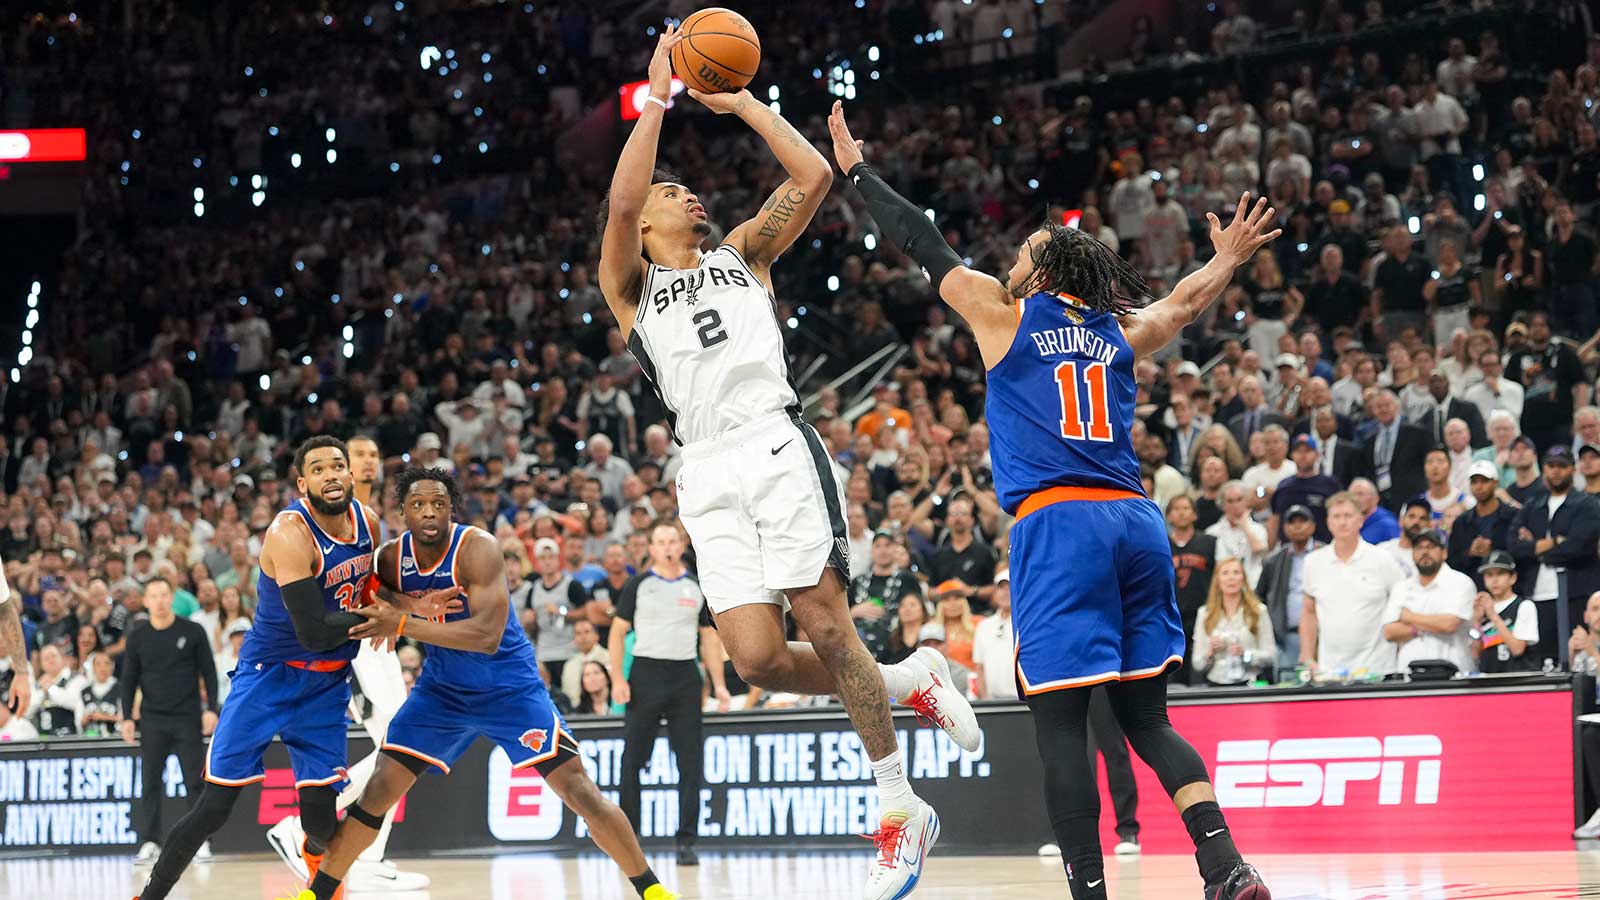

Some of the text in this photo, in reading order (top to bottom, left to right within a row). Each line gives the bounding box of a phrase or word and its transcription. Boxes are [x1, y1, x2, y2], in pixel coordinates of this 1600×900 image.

[758, 187, 806, 238] WAWG
[653, 266, 750, 315] SPURS
[692, 308, 729, 349] 2
[1030, 326, 1120, 367] BRUNSON
[1053, 360, 1114, 443] 11
[324, 559, 352, 589] NEW
[352, 552, 373, 576] YOR
[27, 758, 69, 801] THE
[71, 756, 133, 800] ESPN
[703, 735, 751, 784] ON
[755, 732, 816, 783] THE
[1213, 734, 1443, 809] ESPN
[4, 802, 137, 845] ANYWHERE.
[725, 785, 881, 836] ANYWHER
